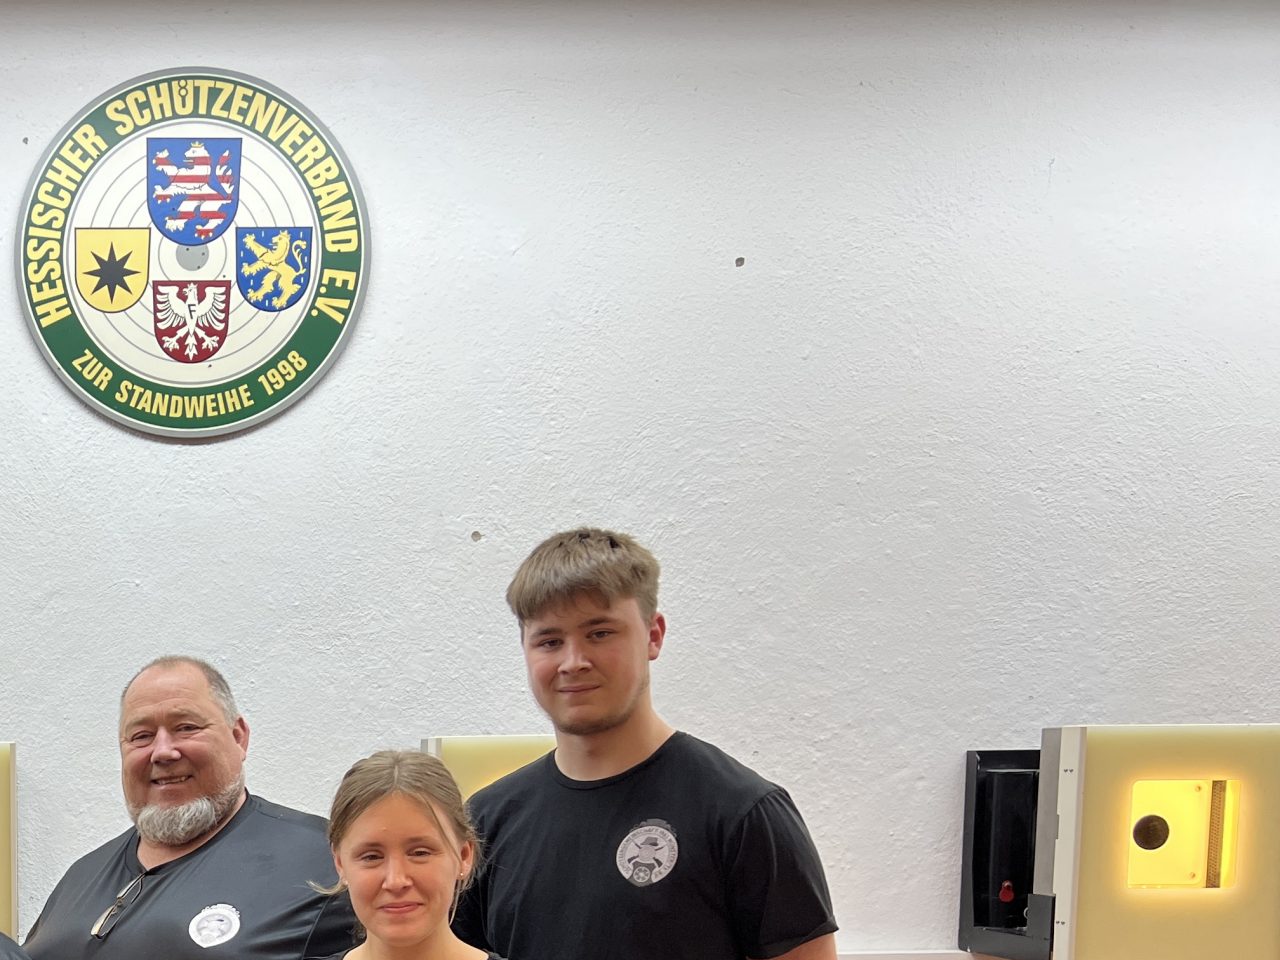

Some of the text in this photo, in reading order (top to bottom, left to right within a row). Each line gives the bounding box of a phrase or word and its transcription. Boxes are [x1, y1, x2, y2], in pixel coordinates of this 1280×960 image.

[26, 123, 108, 328] HESSISCHER
[310, 268, 357, 324] E.V.
[72, 348, 308, 419] ZUR STANDWEIHE 1998
